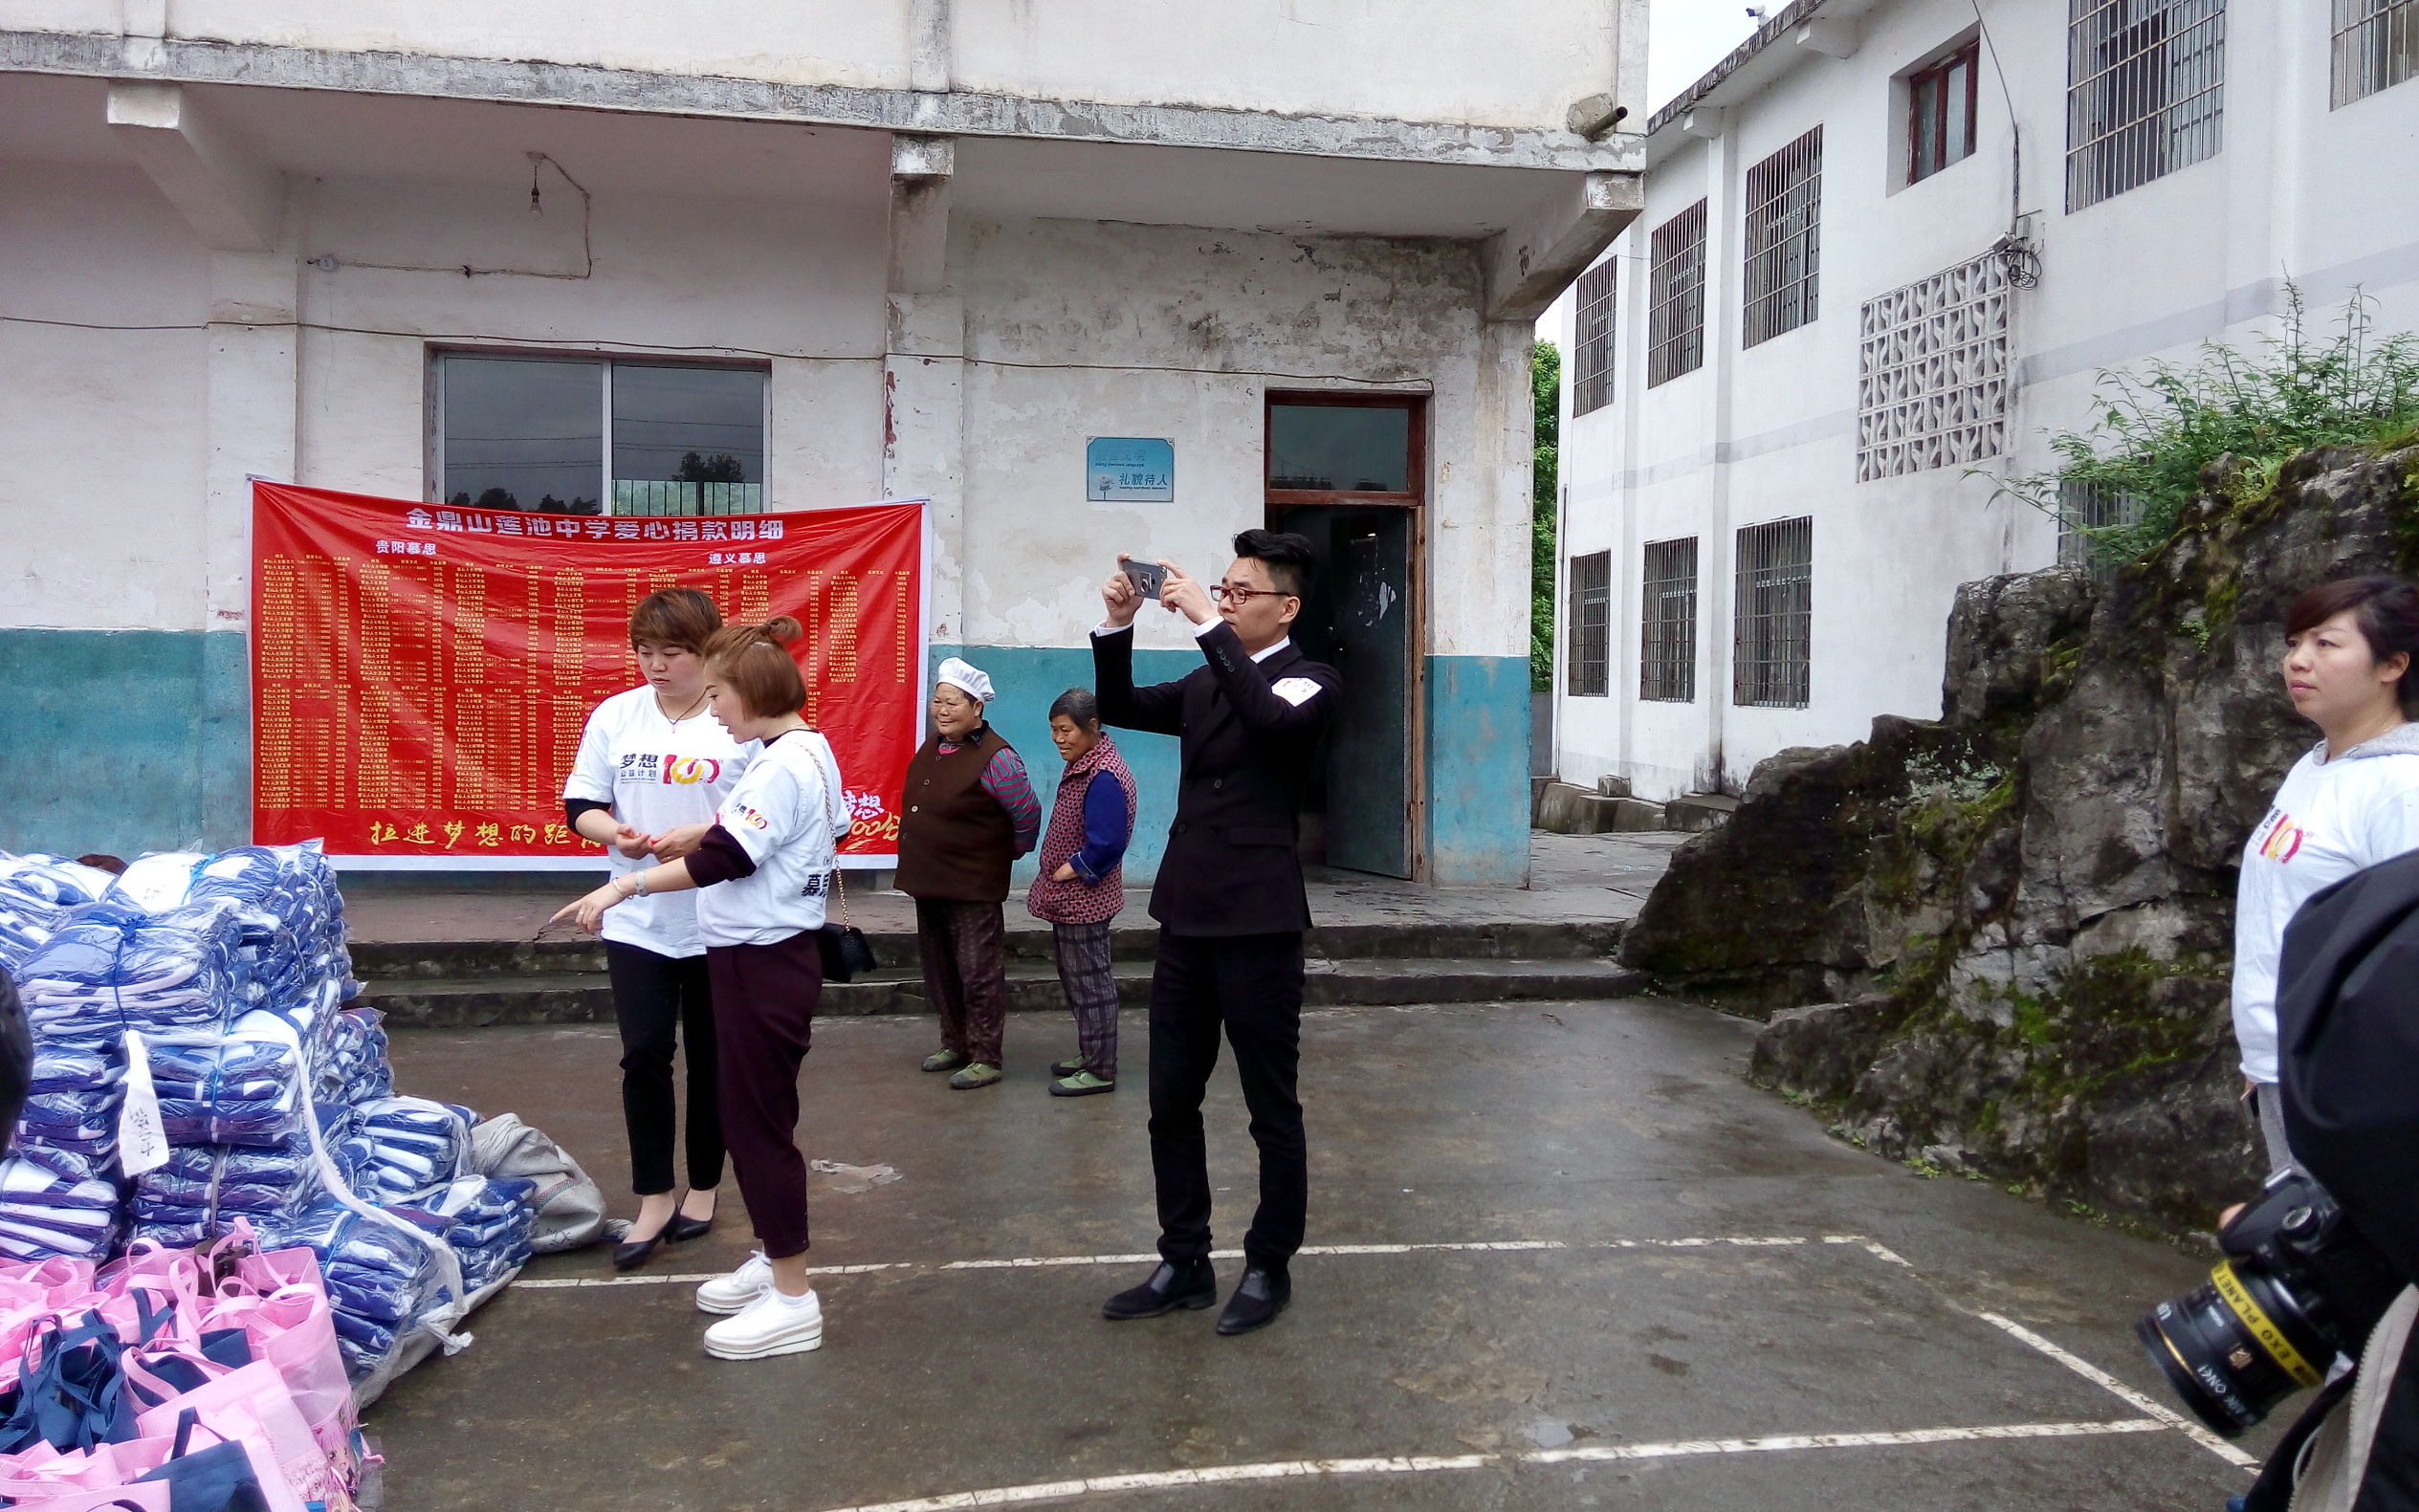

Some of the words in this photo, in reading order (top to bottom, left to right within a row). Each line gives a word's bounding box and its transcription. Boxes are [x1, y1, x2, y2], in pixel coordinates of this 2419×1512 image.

[1118, 472, 1168, 486] 礼貌待人
[406, 507, 784, 541] 金鼎山莲池中学爱心捐款明细
[376, 539, 437, 556] 贵阳慕思
[708, 552, 766, 564] 遵义慕思
[620, 753, 658, 769] 梦想
[620, 769, 657, 778] 公益计划
[2216, 1273, 2258, 1325] PLANET
[2260, 1328, 2293, 1369] EXO
